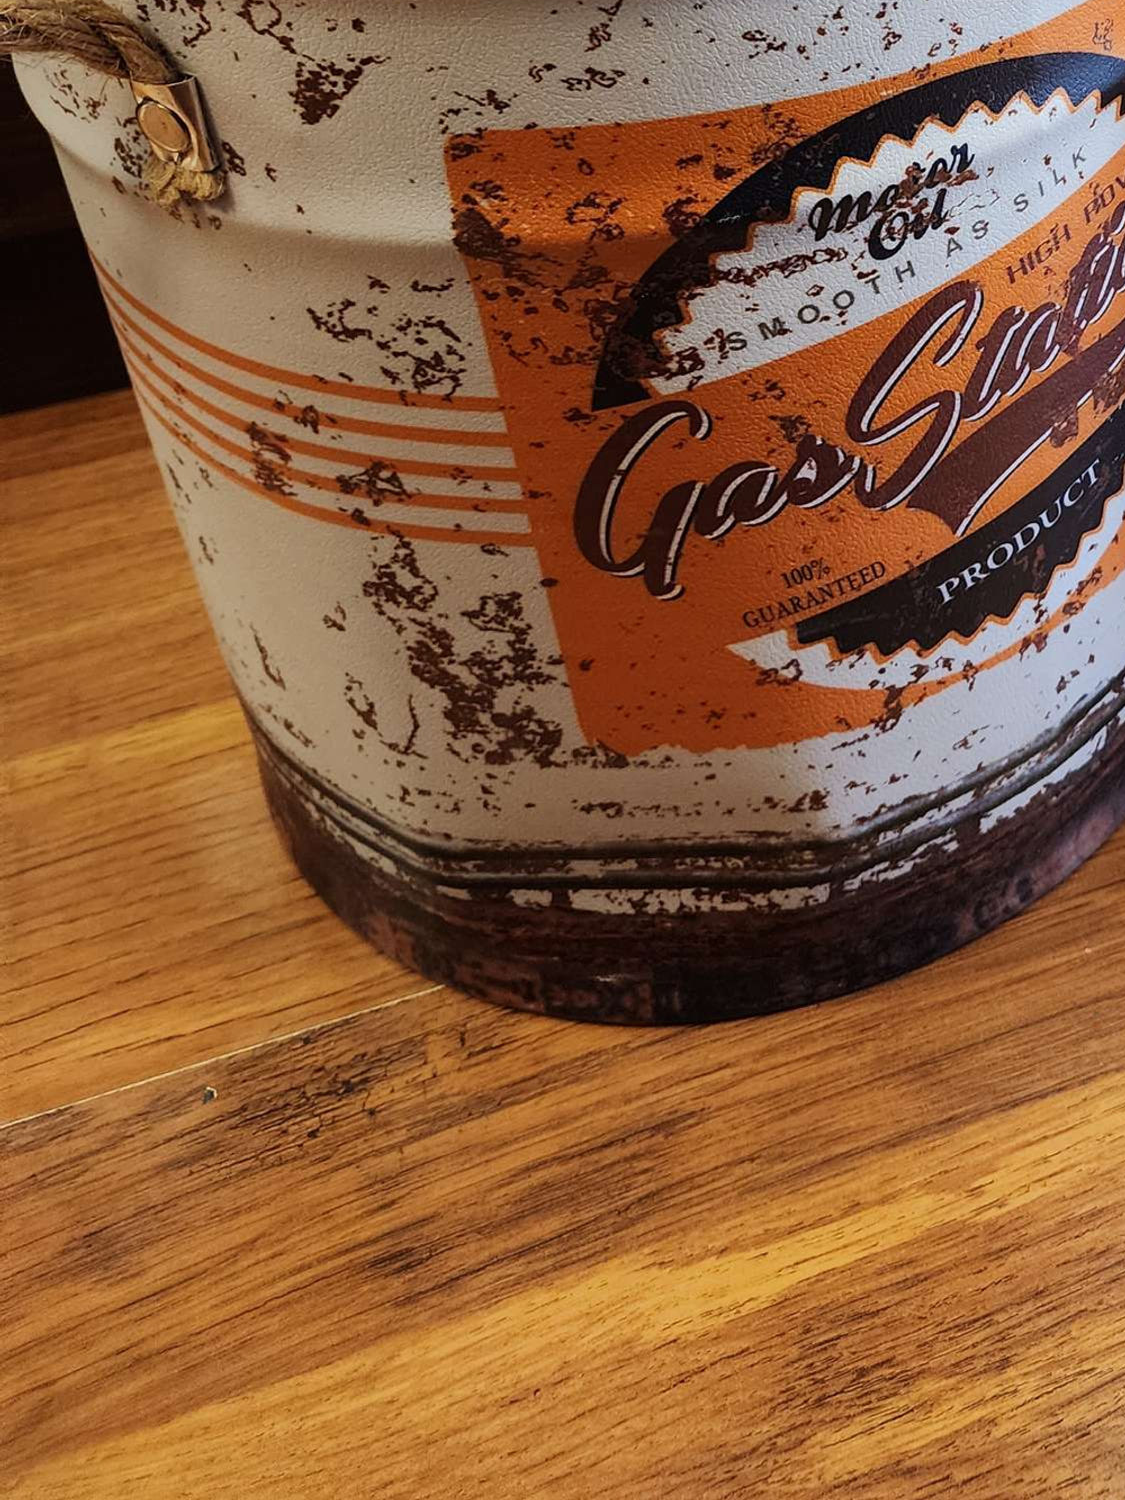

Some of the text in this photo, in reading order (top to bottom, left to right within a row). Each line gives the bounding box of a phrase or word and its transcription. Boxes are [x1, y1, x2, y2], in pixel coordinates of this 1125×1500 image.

[729, 147, 1088, 352] SMOOTH AS SILK
[869, 188, 950, 260] Oil
[1004, 227, 1071, 285] HIGH
[573, 400, 860, 601] Gas
[936, 458, 1100, 604] PRODUCT
[742, 561, 887, 629] GUARANTEED
[780, 557, 831, 589] 100%
